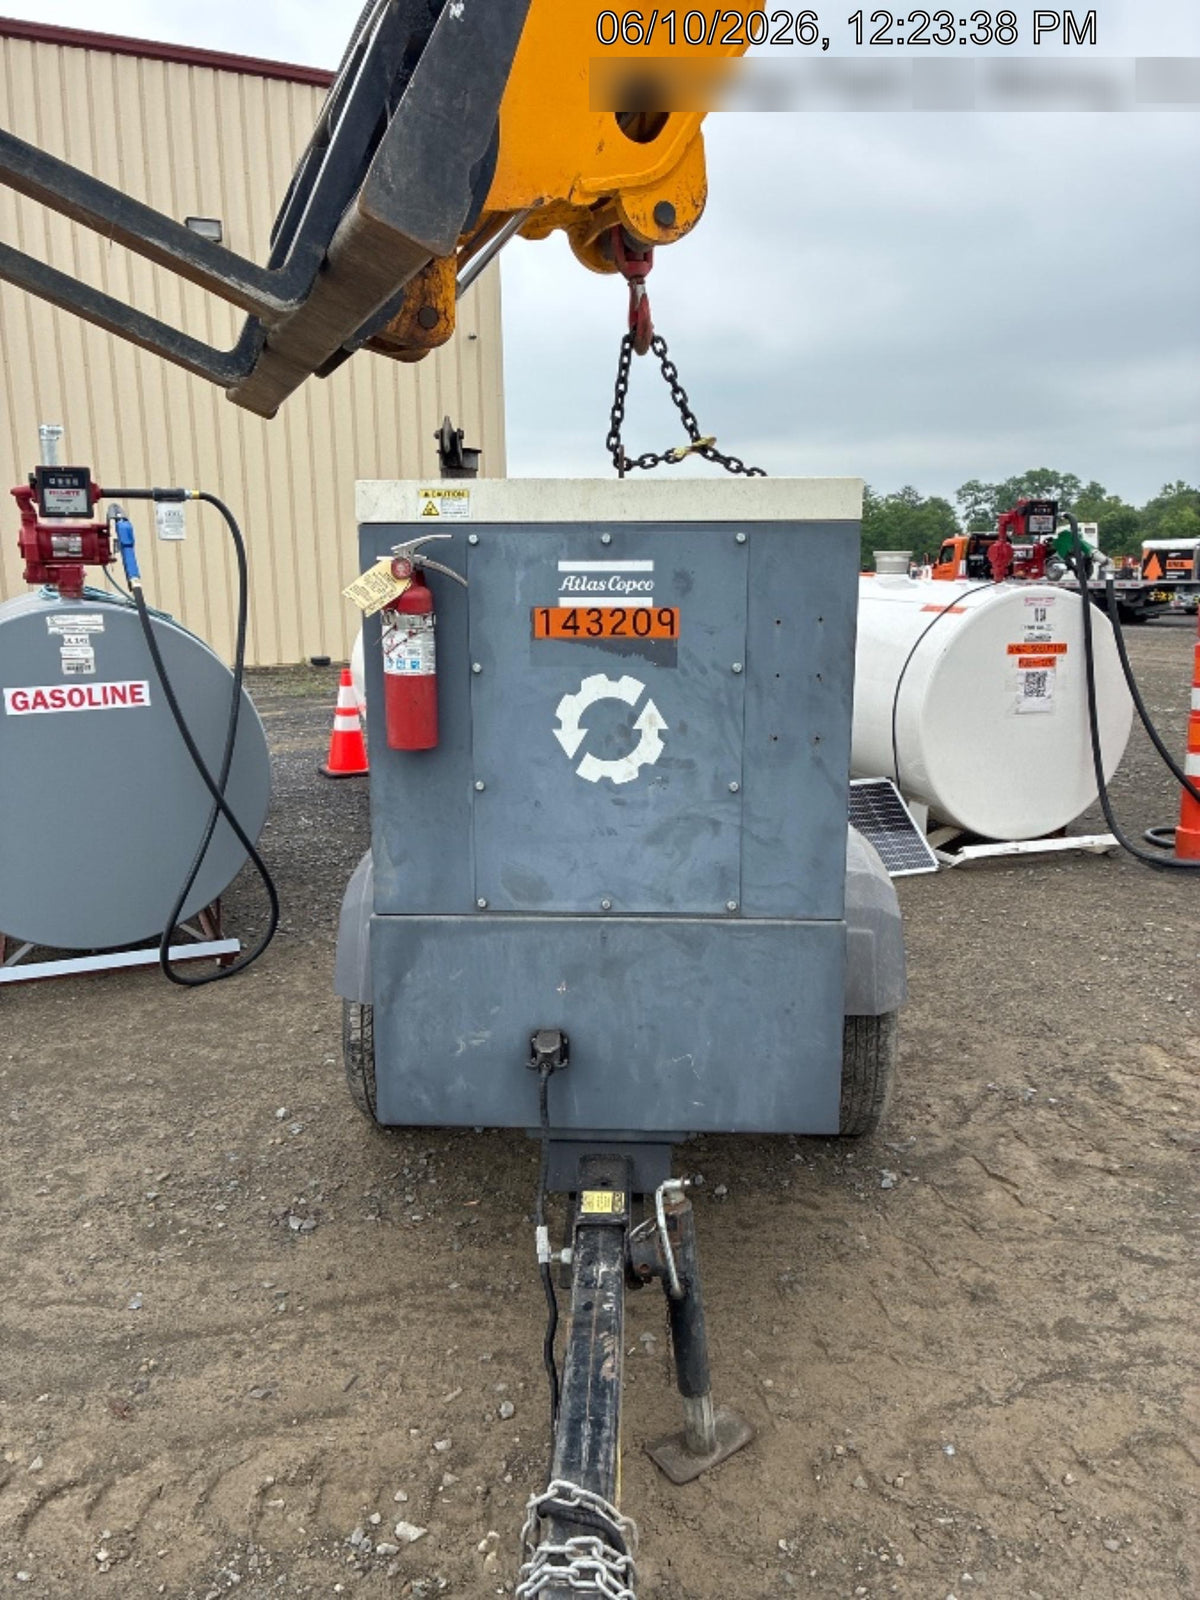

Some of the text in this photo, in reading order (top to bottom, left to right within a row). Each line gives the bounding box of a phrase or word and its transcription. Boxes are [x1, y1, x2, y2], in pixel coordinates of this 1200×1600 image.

[432, 490, 465, 498] CAUTION
[558, 576, 654, 595] Atlas Copco
[539, 608, 675, 636] 143209
[11, 684, 145, 711] GASOLINE
